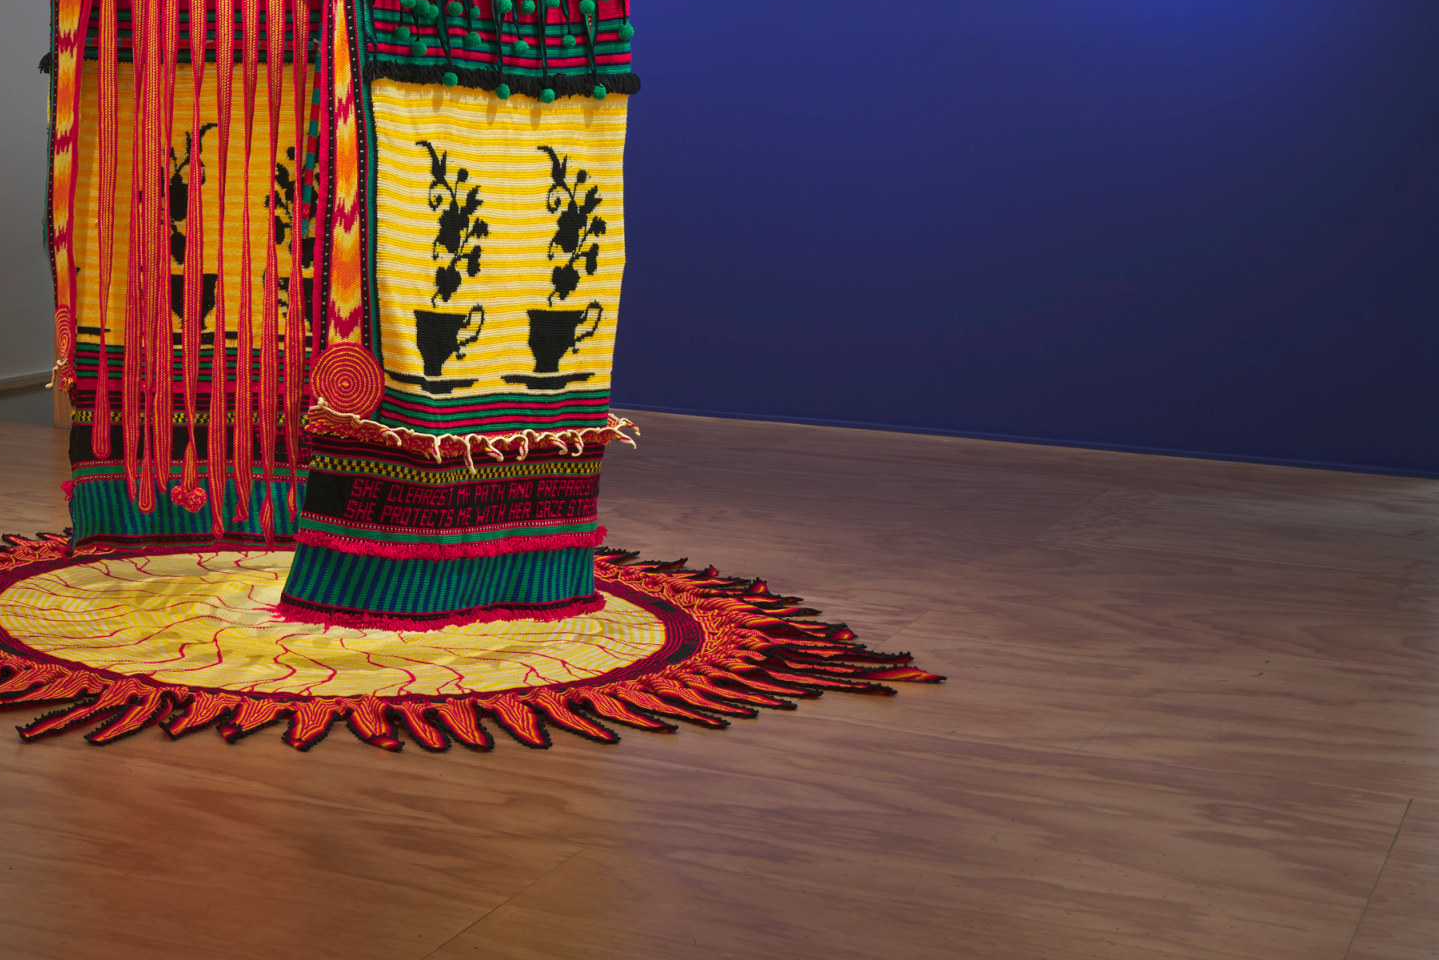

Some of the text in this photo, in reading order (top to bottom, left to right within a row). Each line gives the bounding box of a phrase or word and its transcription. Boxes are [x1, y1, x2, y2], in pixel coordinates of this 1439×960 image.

[350, 478, 384, 500] SHE
[386, 483, 454, 507] CLEAREST
[456, 486, 471, 505] MY
[474, 483, 506, 503] PATH
[508, 480, 534, 500] AND
[343, 499, 377, 522] SHE
[379, 504, 454, 528] PROTECTS
[456, 506, 472, 527] ME
[475, 502, 506, 524] WITH
[508, 500, 533, 520] HER
[536, 500, 566, 519] GAZE
